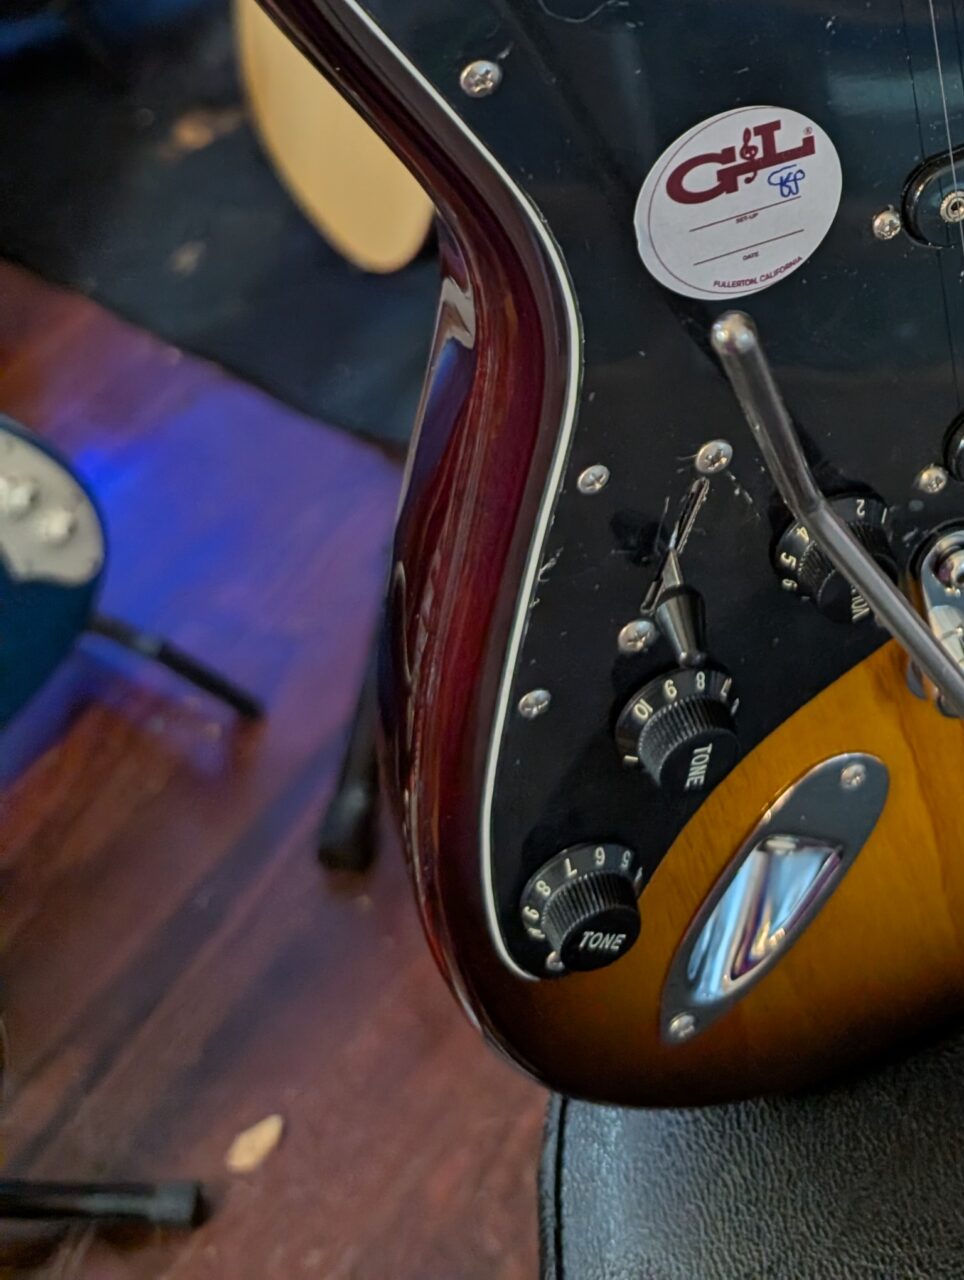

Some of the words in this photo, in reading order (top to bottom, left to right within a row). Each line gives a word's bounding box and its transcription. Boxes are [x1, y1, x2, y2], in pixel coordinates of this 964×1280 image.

[742, 251, 760, 261] DATE
[759, 256, 802, 281] CALIFORNIA
[856, 499, 866, 516] 2
[780, 552, 797, 569] 5
[696, 671, 706, 691] 8
[684, 742, 712, 789] TONE
[536, 880, 551, 896] 8
[578, 931, 626, 950] TONE
